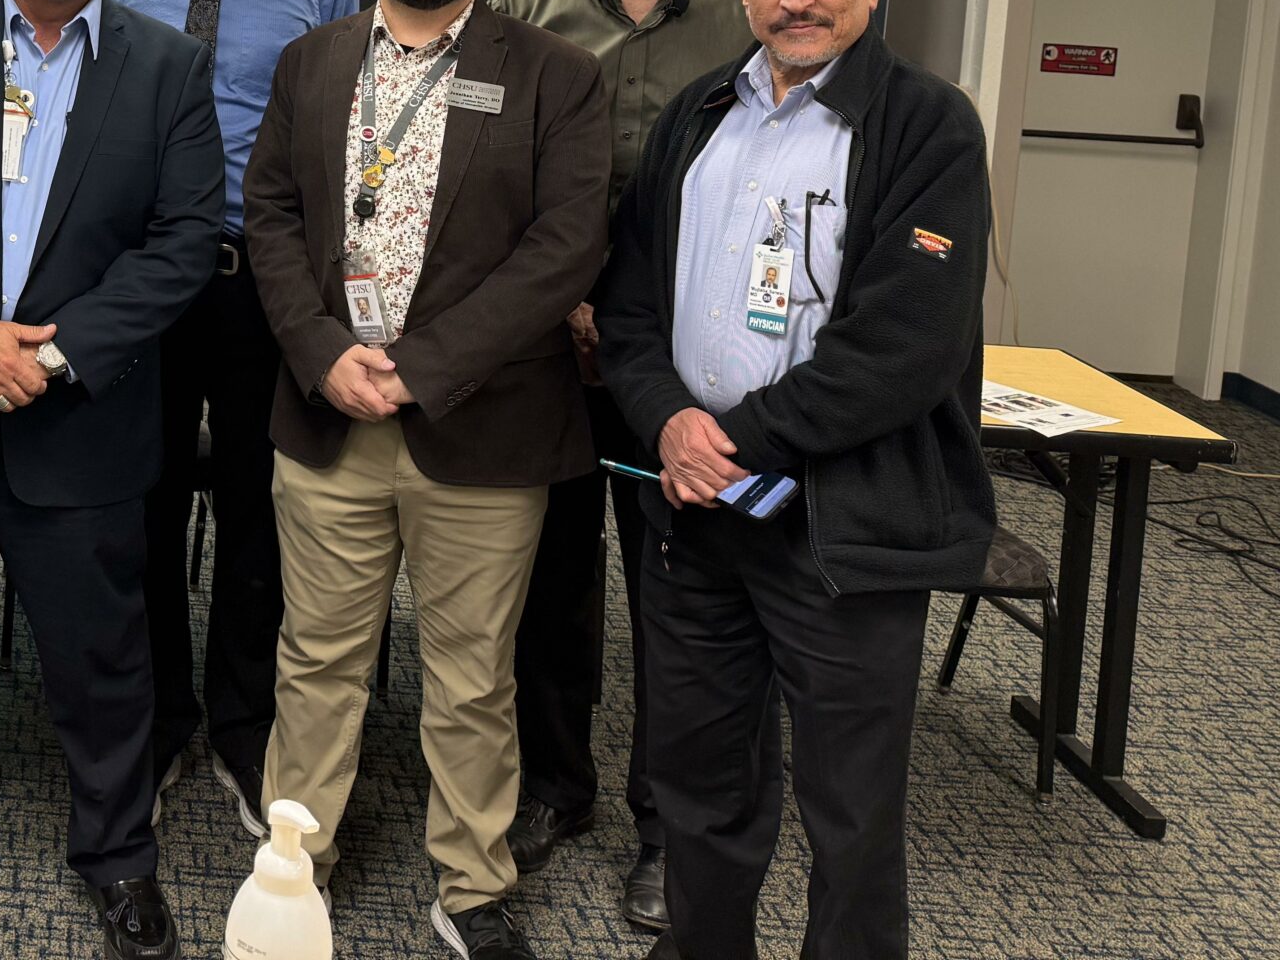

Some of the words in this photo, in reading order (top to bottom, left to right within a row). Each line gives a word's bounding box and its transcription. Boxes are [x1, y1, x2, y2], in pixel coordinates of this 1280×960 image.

[1064, 48, 1097, 57] WARNING
[363, 72, 373, 102] CHSU
[409, 78, 433, 108] CHSU
[452, 82, 478, 92] CHSU
[346, 283, 372, 295] CHSU
[748, 316, 785, 332] PHYSICIAN
